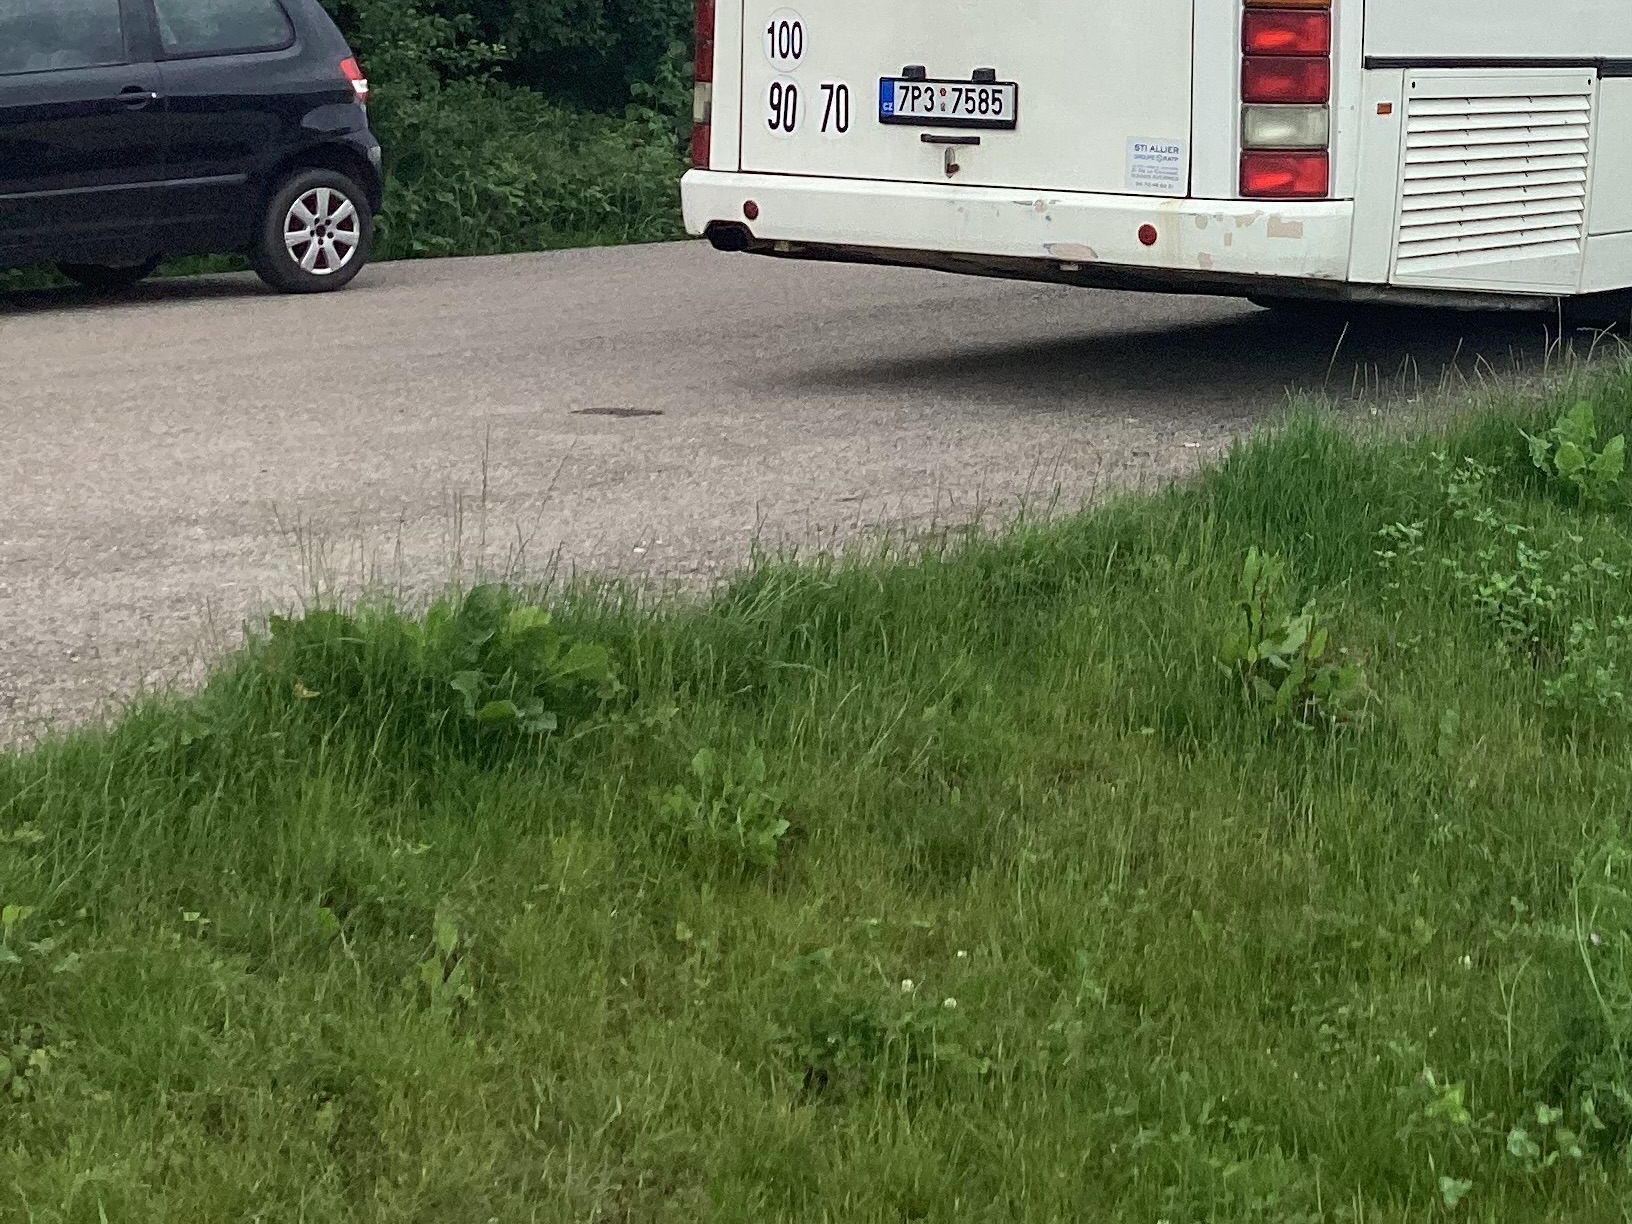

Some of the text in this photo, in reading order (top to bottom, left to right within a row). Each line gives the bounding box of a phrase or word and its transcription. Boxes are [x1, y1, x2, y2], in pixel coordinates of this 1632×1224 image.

[767, 20, 803, 59] 100
[768, 81, 798, 133] 90
[820, 83, 849, 133] 70
[882, 101, 894, 111] CZ
[898, 85, 1003, 115] 7P3 7585
